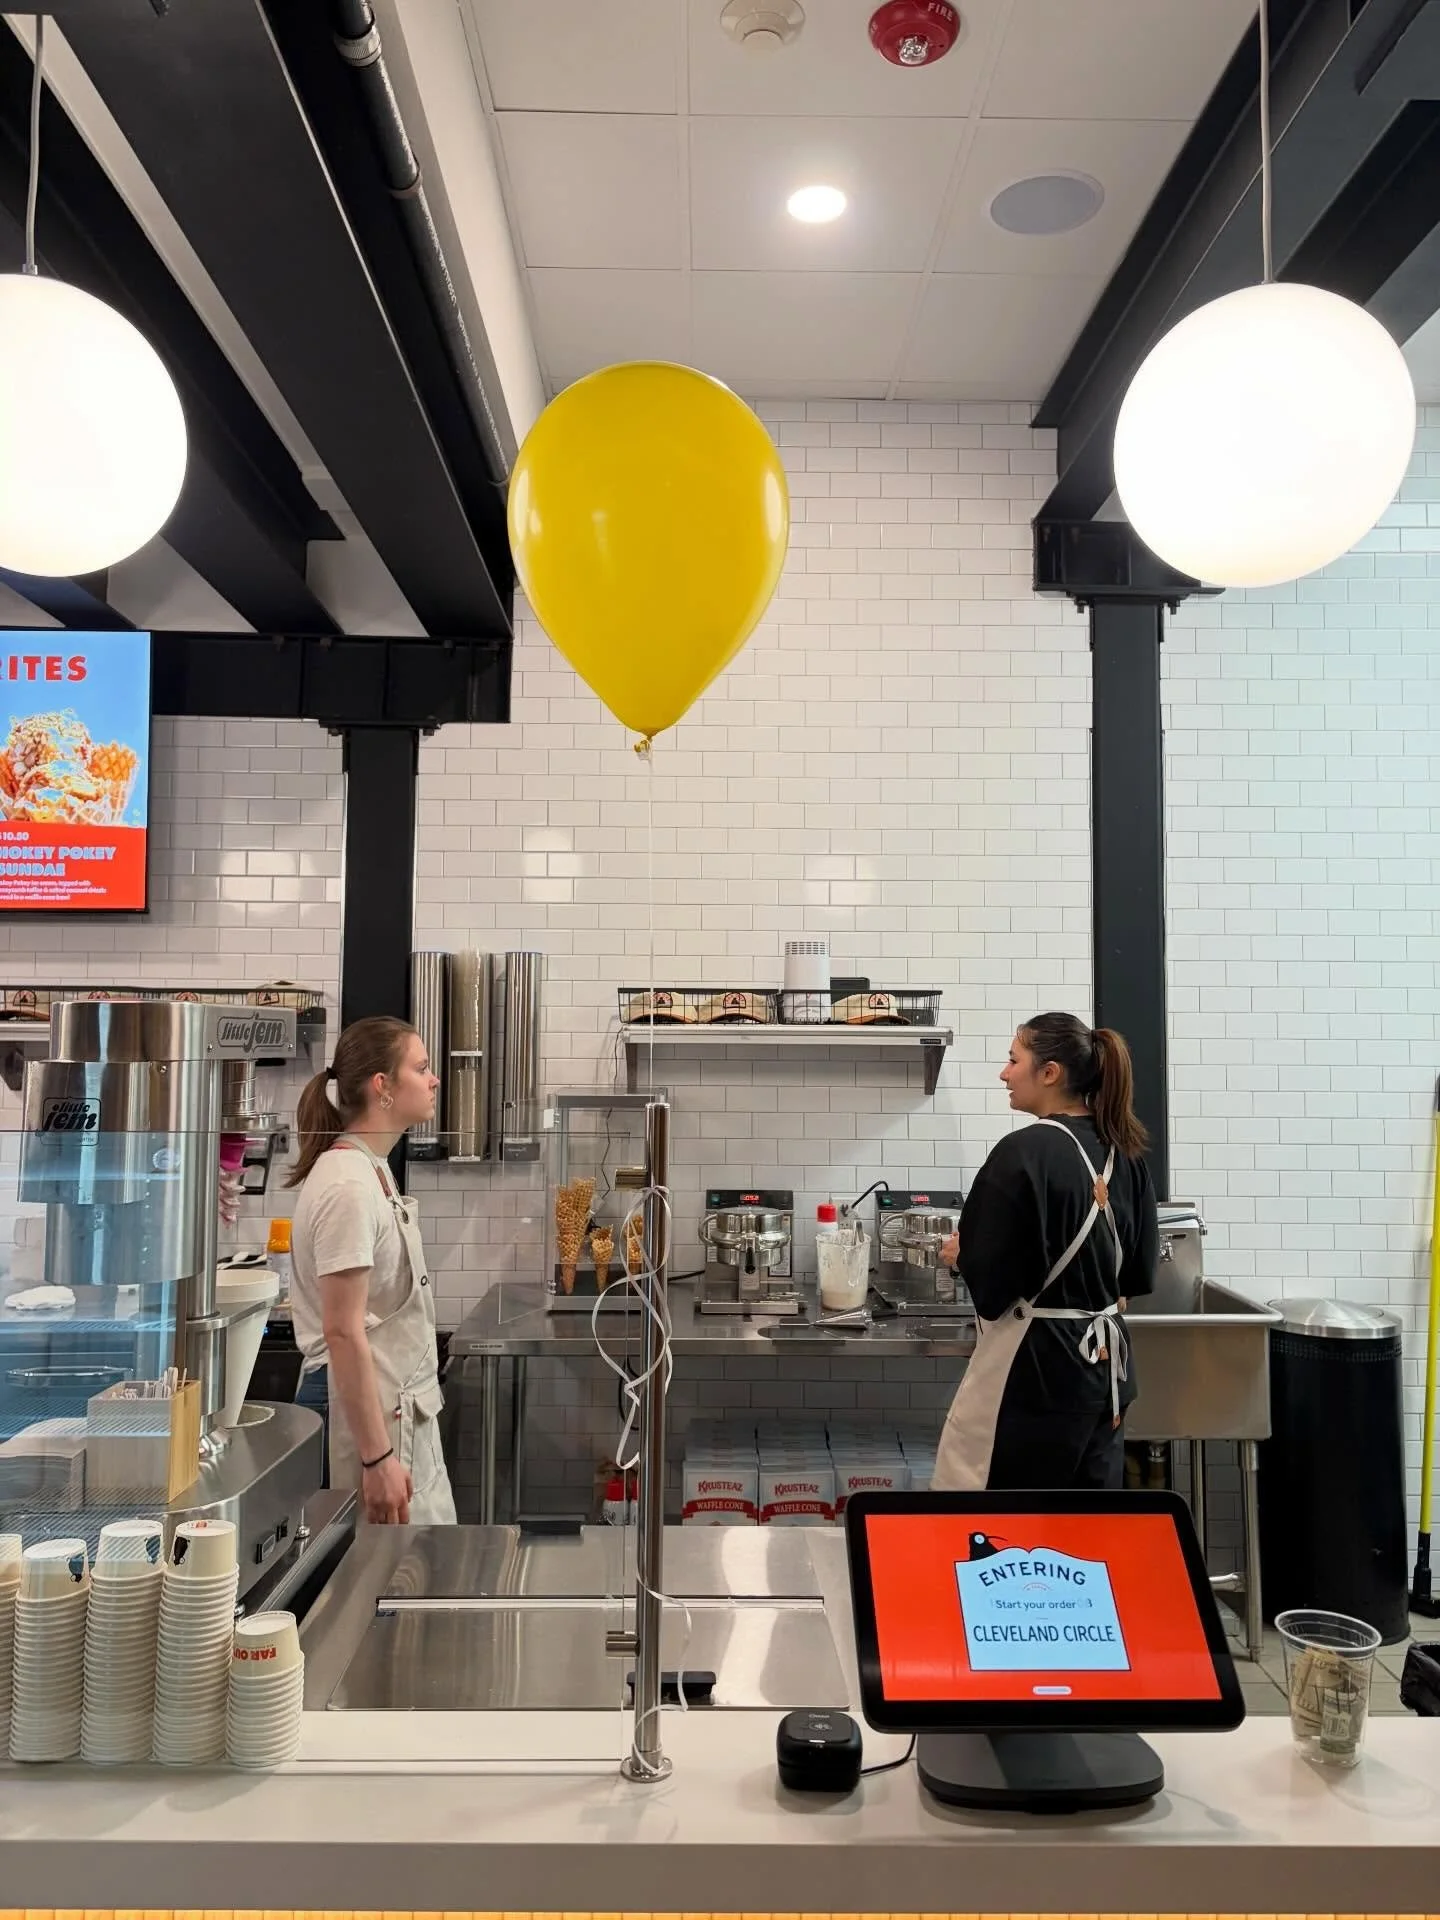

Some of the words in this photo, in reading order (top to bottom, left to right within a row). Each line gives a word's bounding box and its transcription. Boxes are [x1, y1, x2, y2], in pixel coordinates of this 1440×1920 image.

[928, 3, 953, 21] FIRE
[0, 655, 87, 682] ITES
[58, 846, 117, 860] POKEY
[221, 1022, 250, 1040] little
[696, 1501, 723, 1511] WAFFLE
[724, 1500, 745, 1510] CONE
[774, 1504, 800, 1513] WAFFLE
[801, 1503, 821, 1512] CONE
[978, 1561, 1086, 1587] ENTERING
[996, 1600, 1022, 1609] Start
[1024, 1601, 1045, 1611] your
[1049, 1599, 1075, 1609] order
[973, 1625, 1059, 1642] CLEVELAND
[1063, 1625, 1116, 1642] CIRCLE
[250, 1647, 277, 1661] FAR
